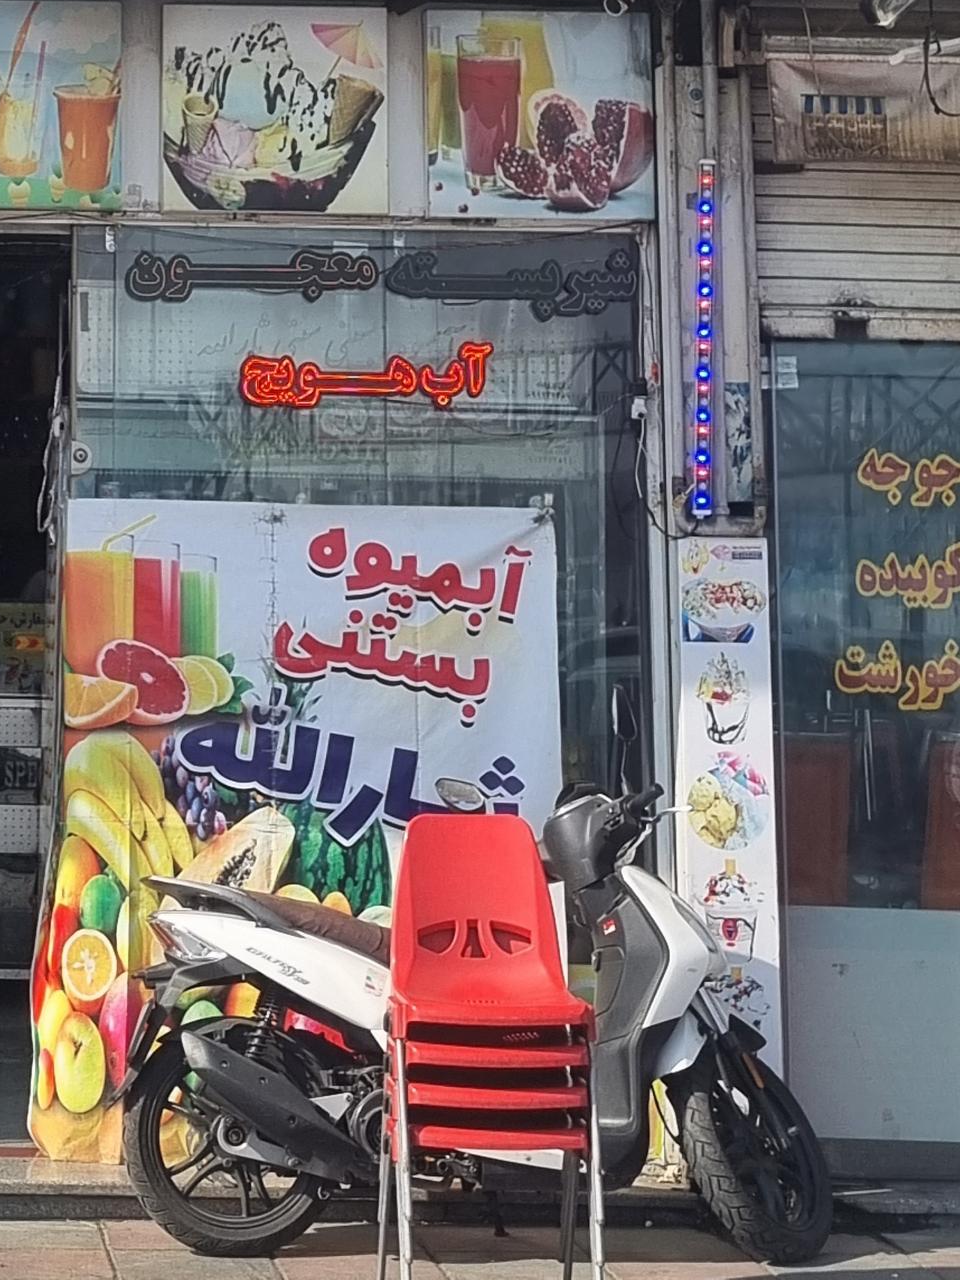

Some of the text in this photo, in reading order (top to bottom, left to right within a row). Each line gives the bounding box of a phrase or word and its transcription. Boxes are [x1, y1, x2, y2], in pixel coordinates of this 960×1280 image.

[129, 252, 377, 300] معجون
[242, 342, 494, 407] آب هویج
[308, 526, 533, 635] آبمیوه
[273, 609, 491, 727] بستنی
